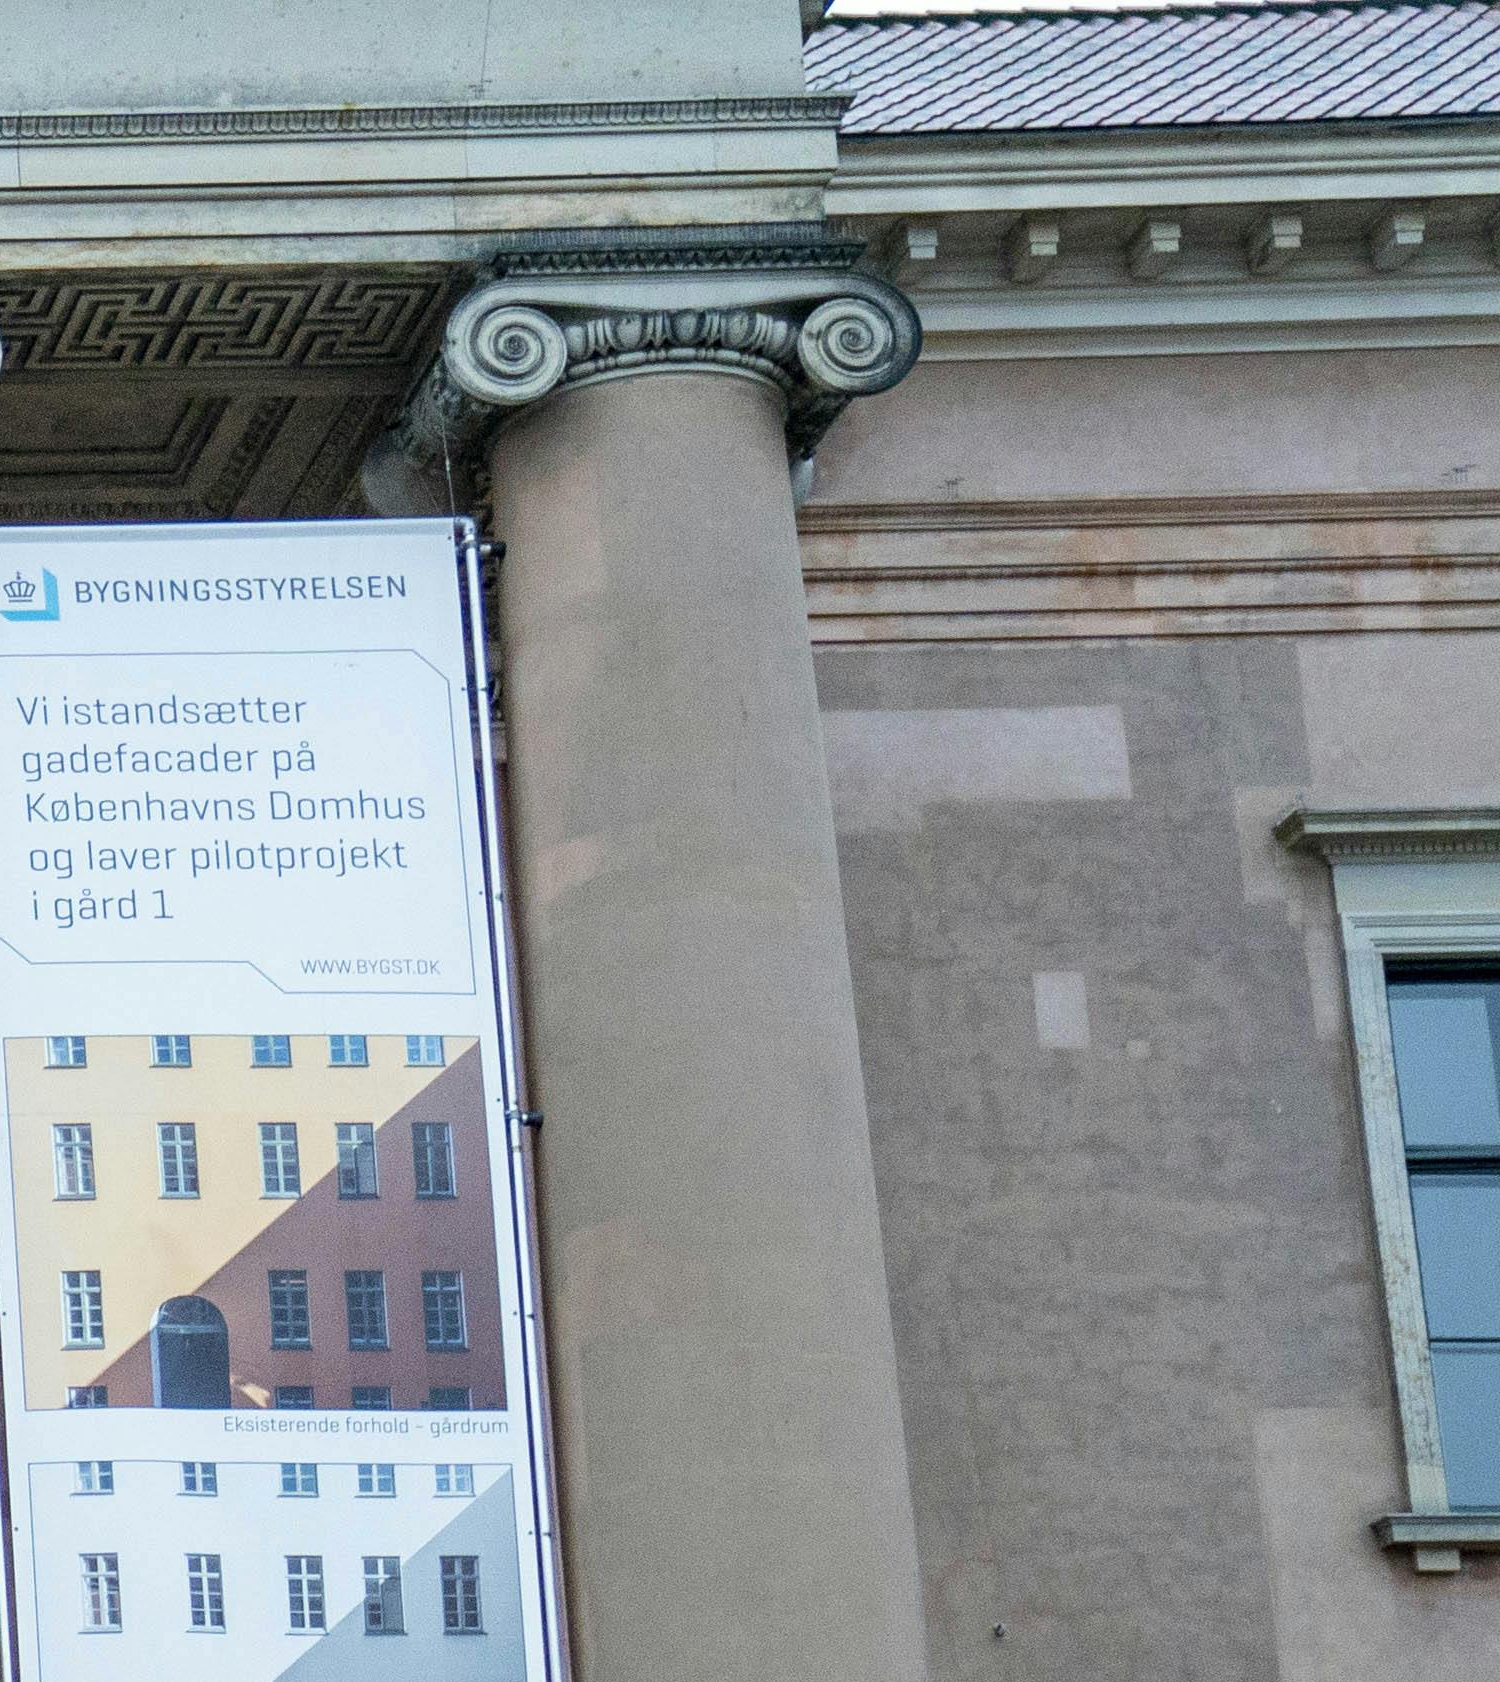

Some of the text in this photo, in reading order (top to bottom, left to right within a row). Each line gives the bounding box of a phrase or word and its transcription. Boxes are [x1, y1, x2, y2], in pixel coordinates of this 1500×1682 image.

[75, 574, 407, 605] BYGNINGSSTYRELSEN
[16, 695, 307, 727] Vi istandsætter
[21, 740, 316, 783] gadefacader på
[26, 790, 426, 823] Københavns Domhus
[28, 839, 408, 880] og laver pilotprojekt
[32, 888, 175, 930] i gård 1
[300, 958, 441, 976] WWW.BYGST.DK
[223, 1416, 340, 1433] Eksisterende
[345, 1416, 409, 1434] forhold
[429, 1416, 509, 1438] gårdrum
